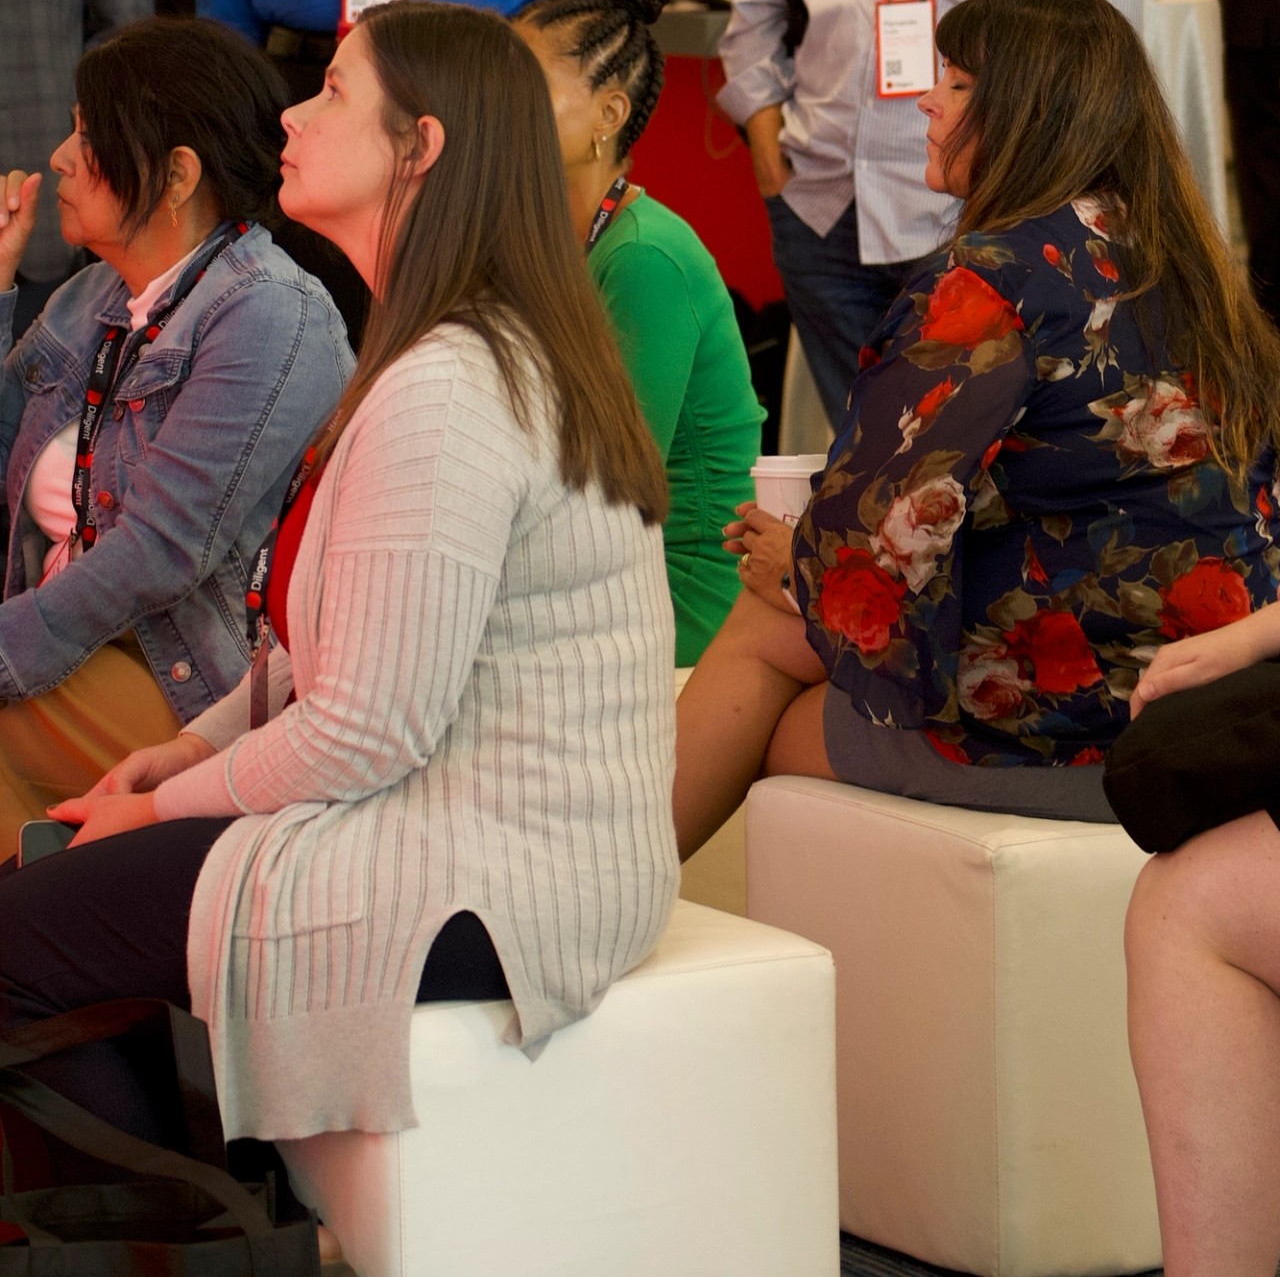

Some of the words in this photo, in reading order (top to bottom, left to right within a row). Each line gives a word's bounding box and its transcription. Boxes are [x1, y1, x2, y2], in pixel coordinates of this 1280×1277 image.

[95, 341, 112, 375] Diligent
[82, 405, 97, 441] Diligent
[251, 548, 269, 592] Diligent
